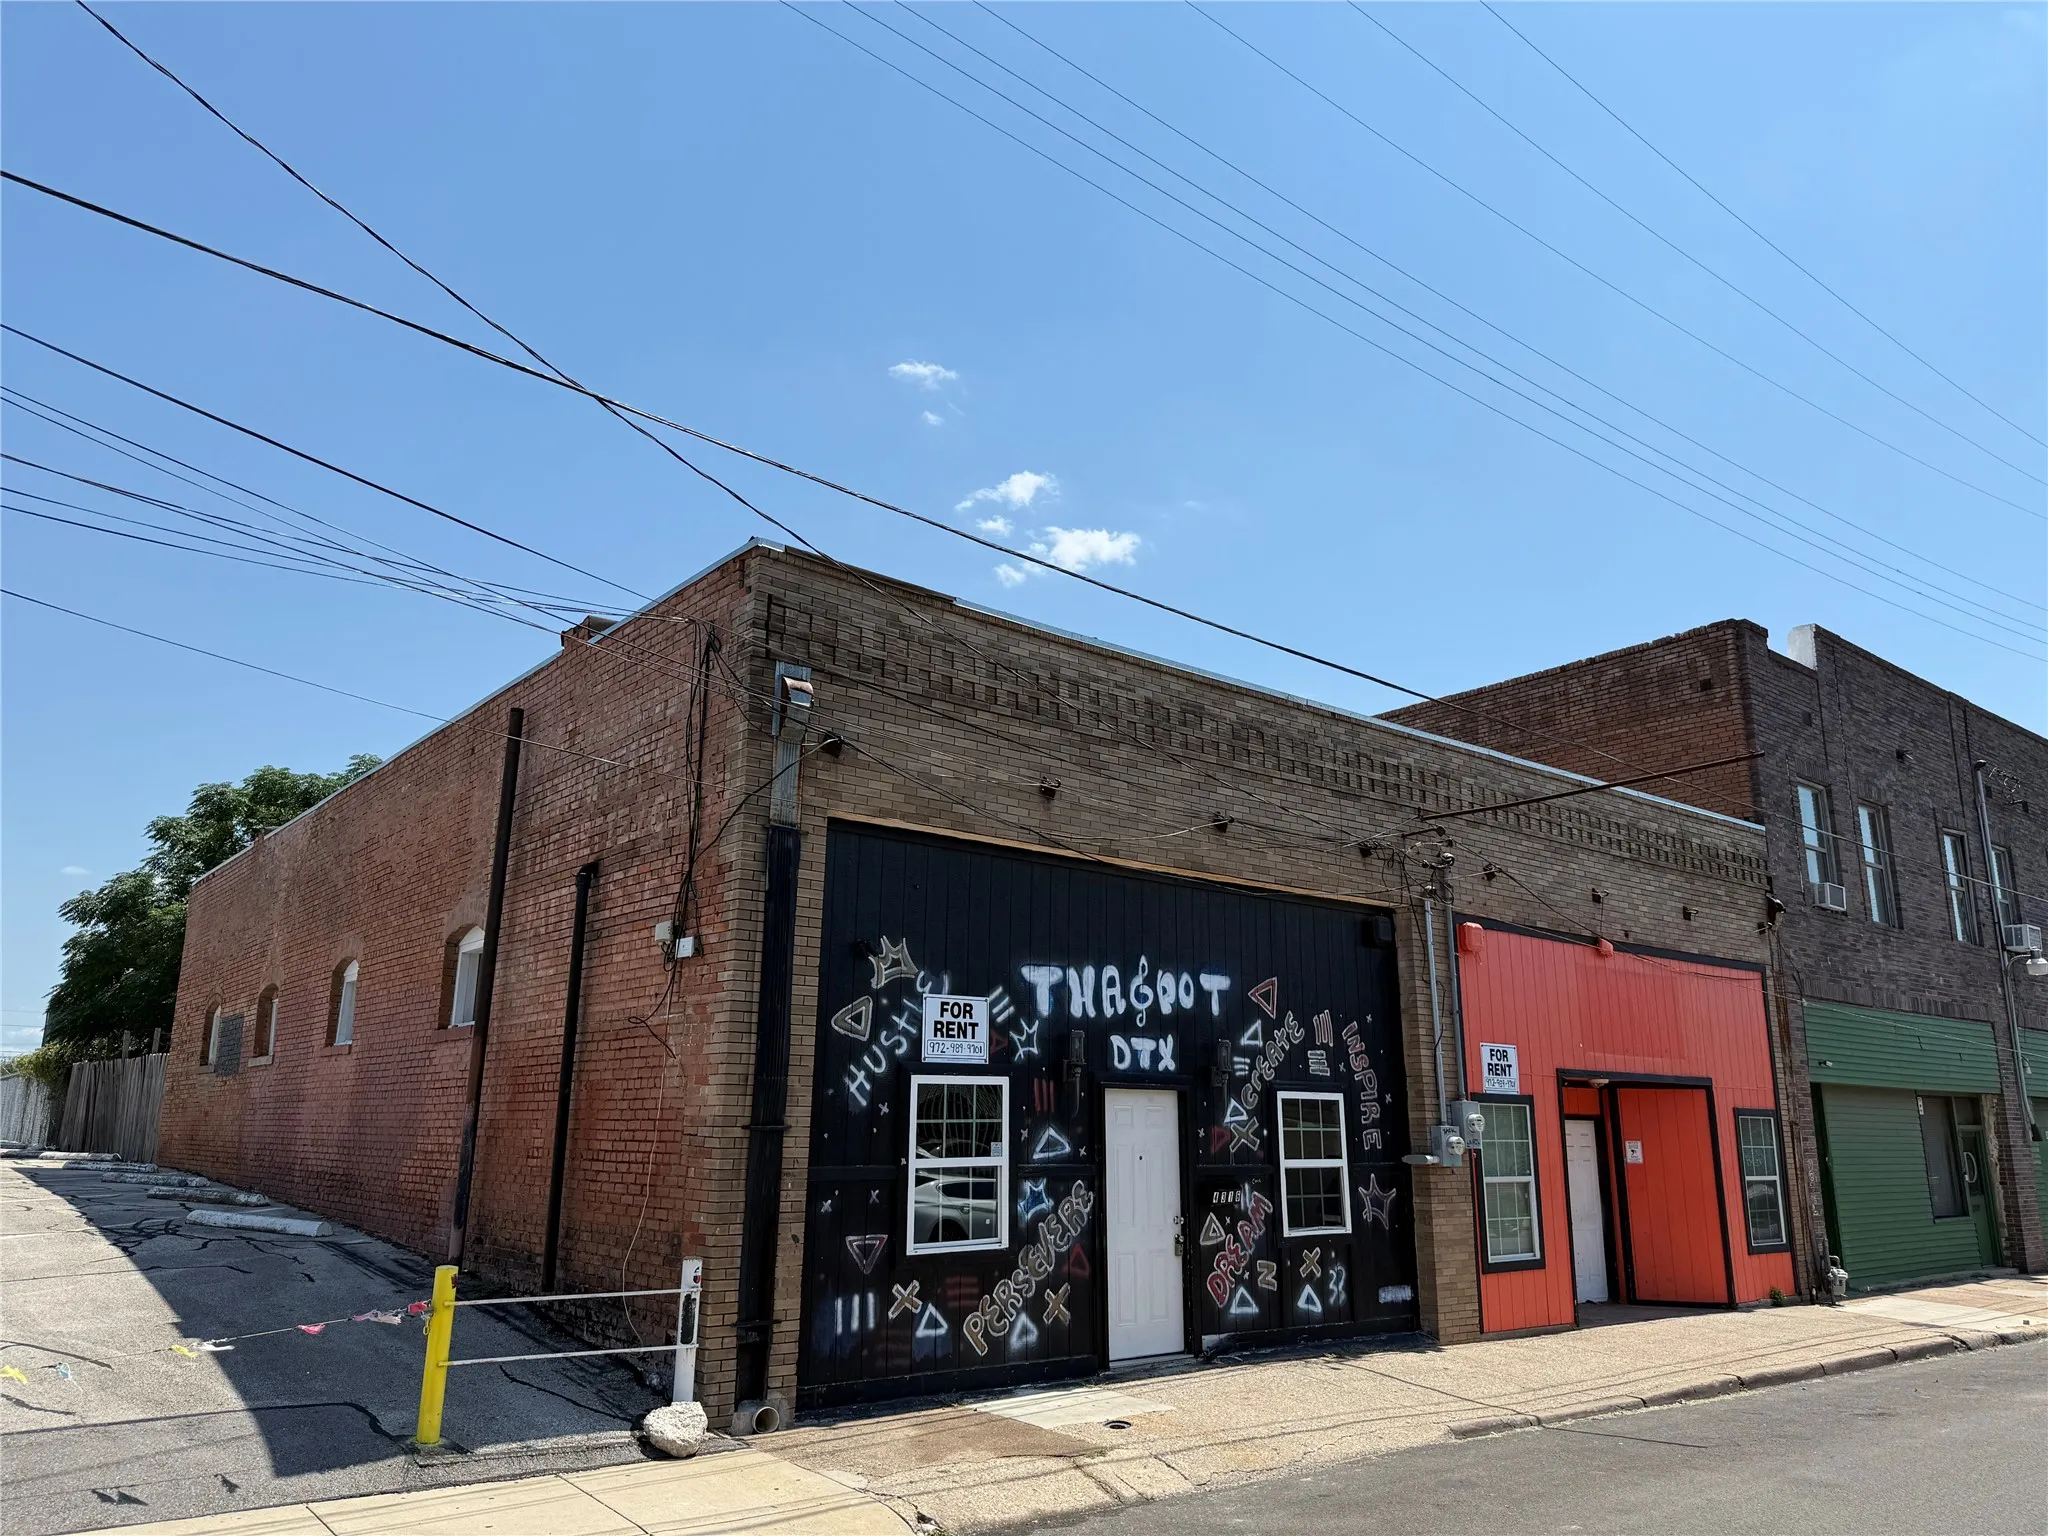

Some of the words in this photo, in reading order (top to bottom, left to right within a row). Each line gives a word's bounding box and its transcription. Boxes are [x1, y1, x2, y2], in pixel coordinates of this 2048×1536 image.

[939, 1001, 973, 1019] FOR
[933, 1020, 979, 1039] RENT
[929, 1041, 983, 1054] 972-989-9701
[1110, 1034, 1176, 1072] DTX
[1489, 1048, 1509, 1062] FOR
[1487, 1062, 1513, 1077] RENT
[1341, 1020, 1382, 1151] INSPIRE
[1206, 1190, 1274, 1308] DREAM
[963, 1179, 1094, 1357] PERSEVERE
